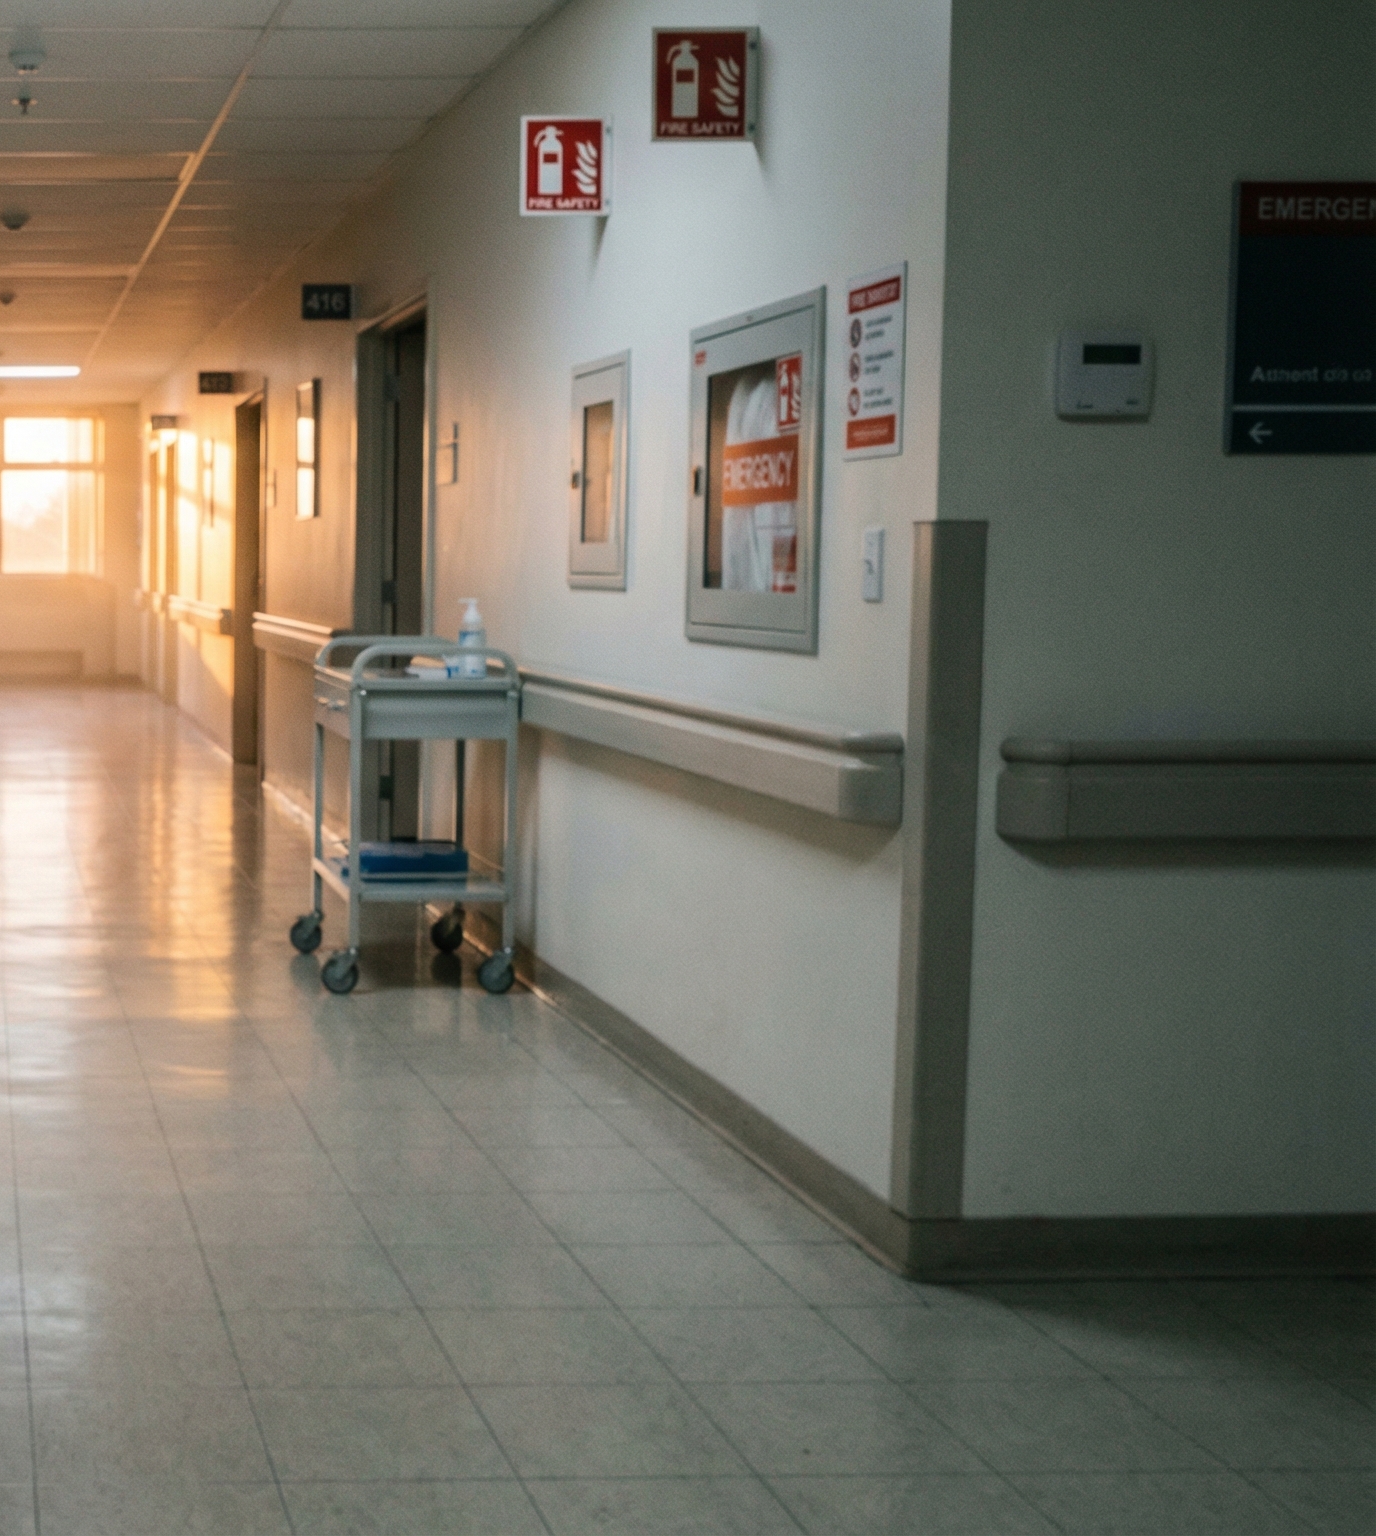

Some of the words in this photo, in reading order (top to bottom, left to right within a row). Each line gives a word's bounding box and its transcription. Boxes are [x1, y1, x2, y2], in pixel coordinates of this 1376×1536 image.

[659, 121, 688, 135] FIRE
[691, 121, 742, 135] SAFETY
[528, 197, 553, 209] FIRE
[556, 197, 600, 210] SAFETY
[306, 292, 345, 312] 416
[722, 450, 794, 491] EMERGENCY
